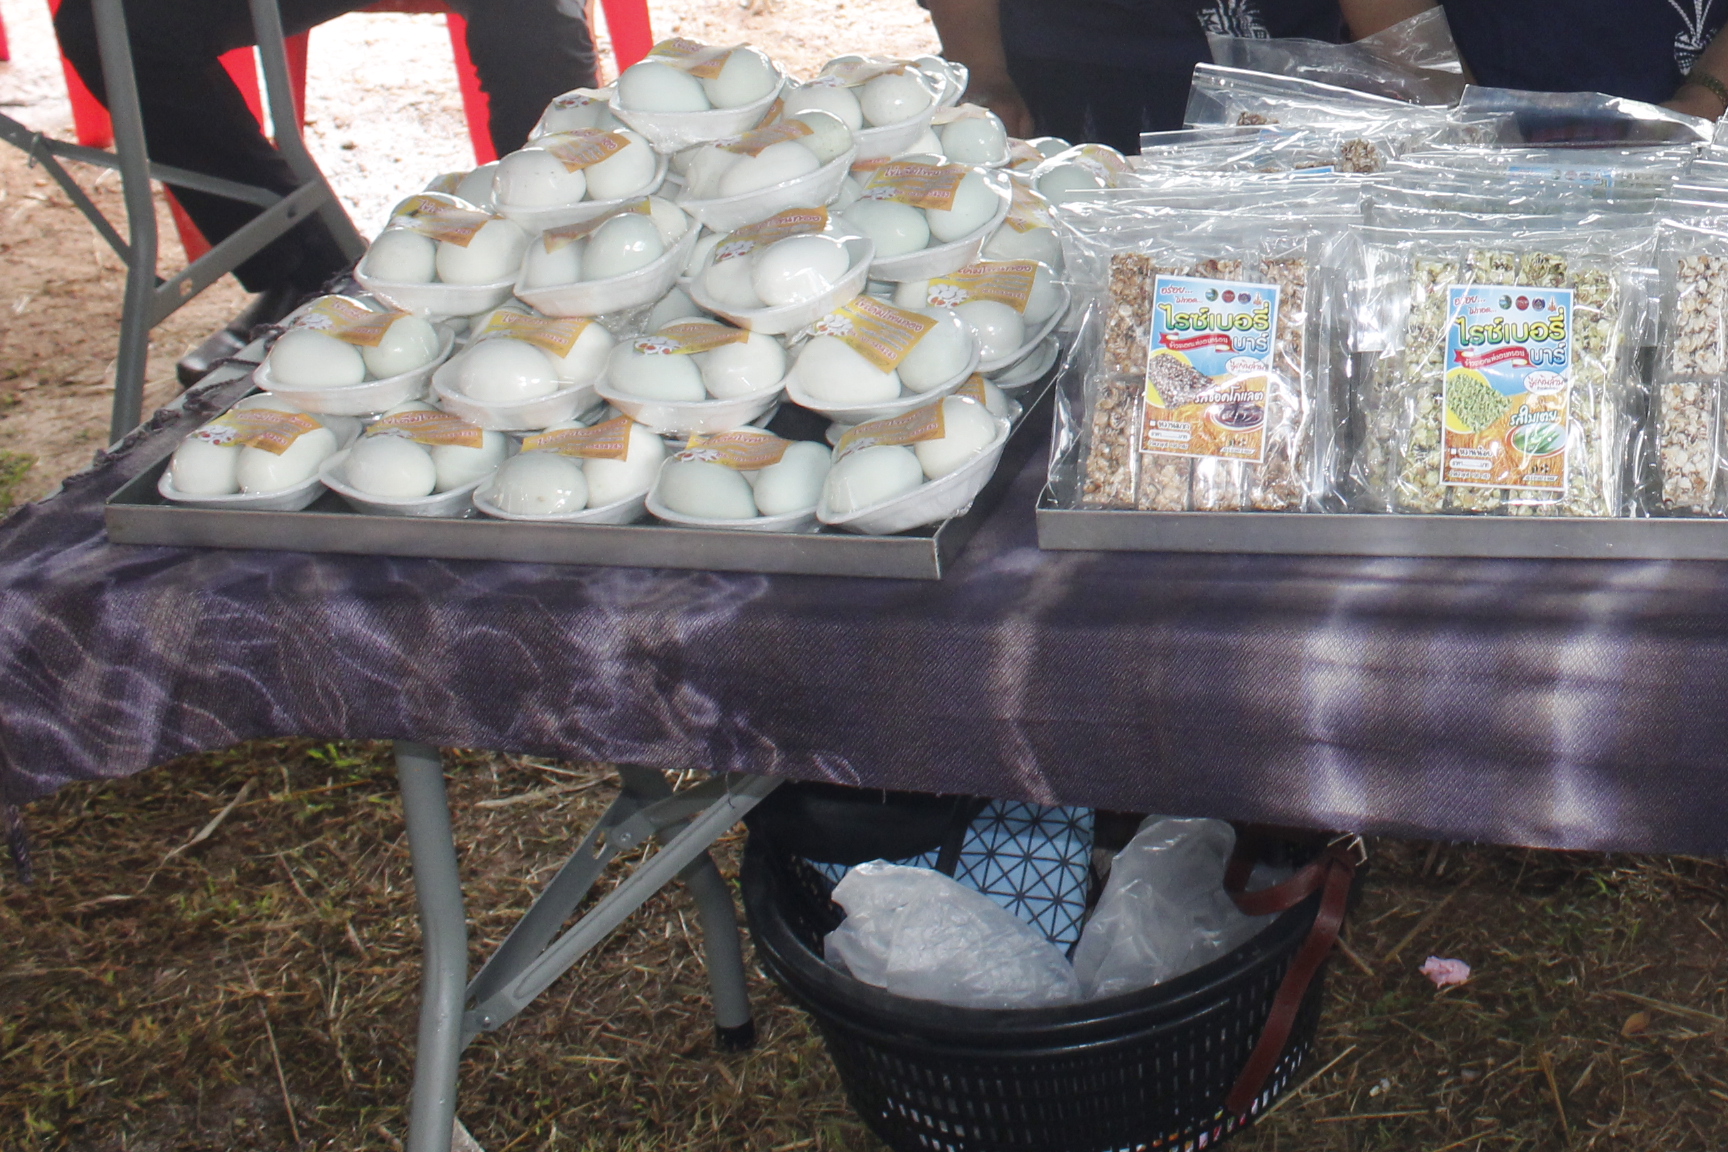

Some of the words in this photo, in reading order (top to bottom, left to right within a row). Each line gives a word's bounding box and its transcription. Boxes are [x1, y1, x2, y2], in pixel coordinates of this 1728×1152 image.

[1158, 301, 1271, 332] ไรซ์เบอรี่
[1455, 307, 1567, 346] ไรซ์เบอรี่
[1232, 332, 1269, 352] บาร์
[1529, 342, 1567, 366] บาร์
